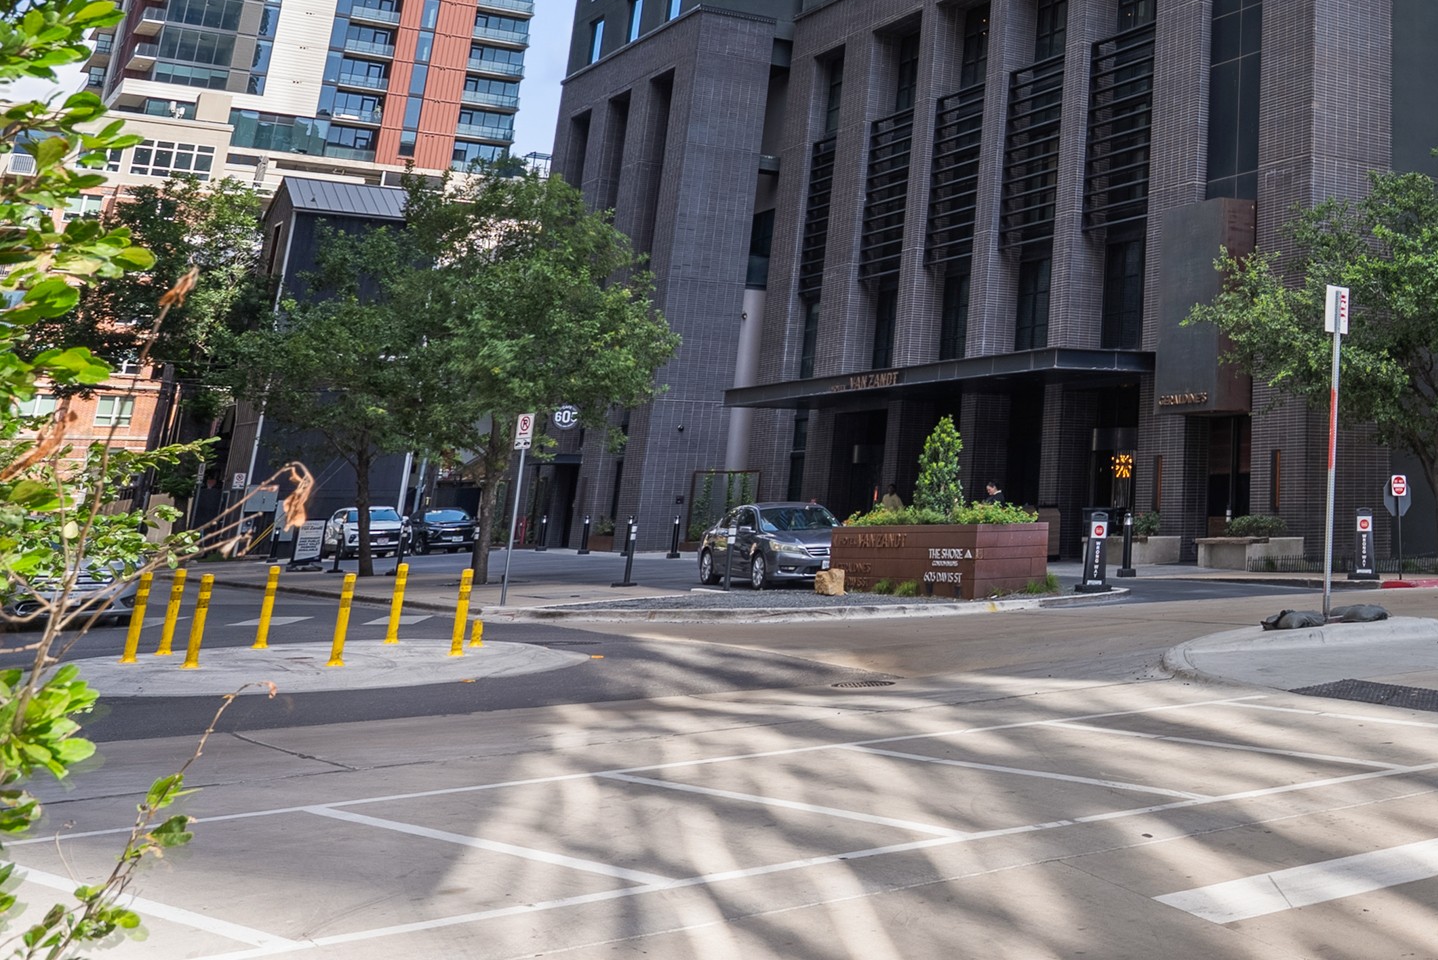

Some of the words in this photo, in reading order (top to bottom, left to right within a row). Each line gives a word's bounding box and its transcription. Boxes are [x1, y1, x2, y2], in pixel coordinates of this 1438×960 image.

[849, 375, 868, 389] VAN
[868, 372, 898, 387] ZANDT
[858, 533, 875, 548] VAN
[875, 533, 908, 548] ZANDT
[928, 548, 941, 559] THE
[941, 548, 963, 559] SHORE
[923, 571, 936, 582] 605
[936, 572, 953, 583] DAVIS
[954, 572, 963, 583] ST
